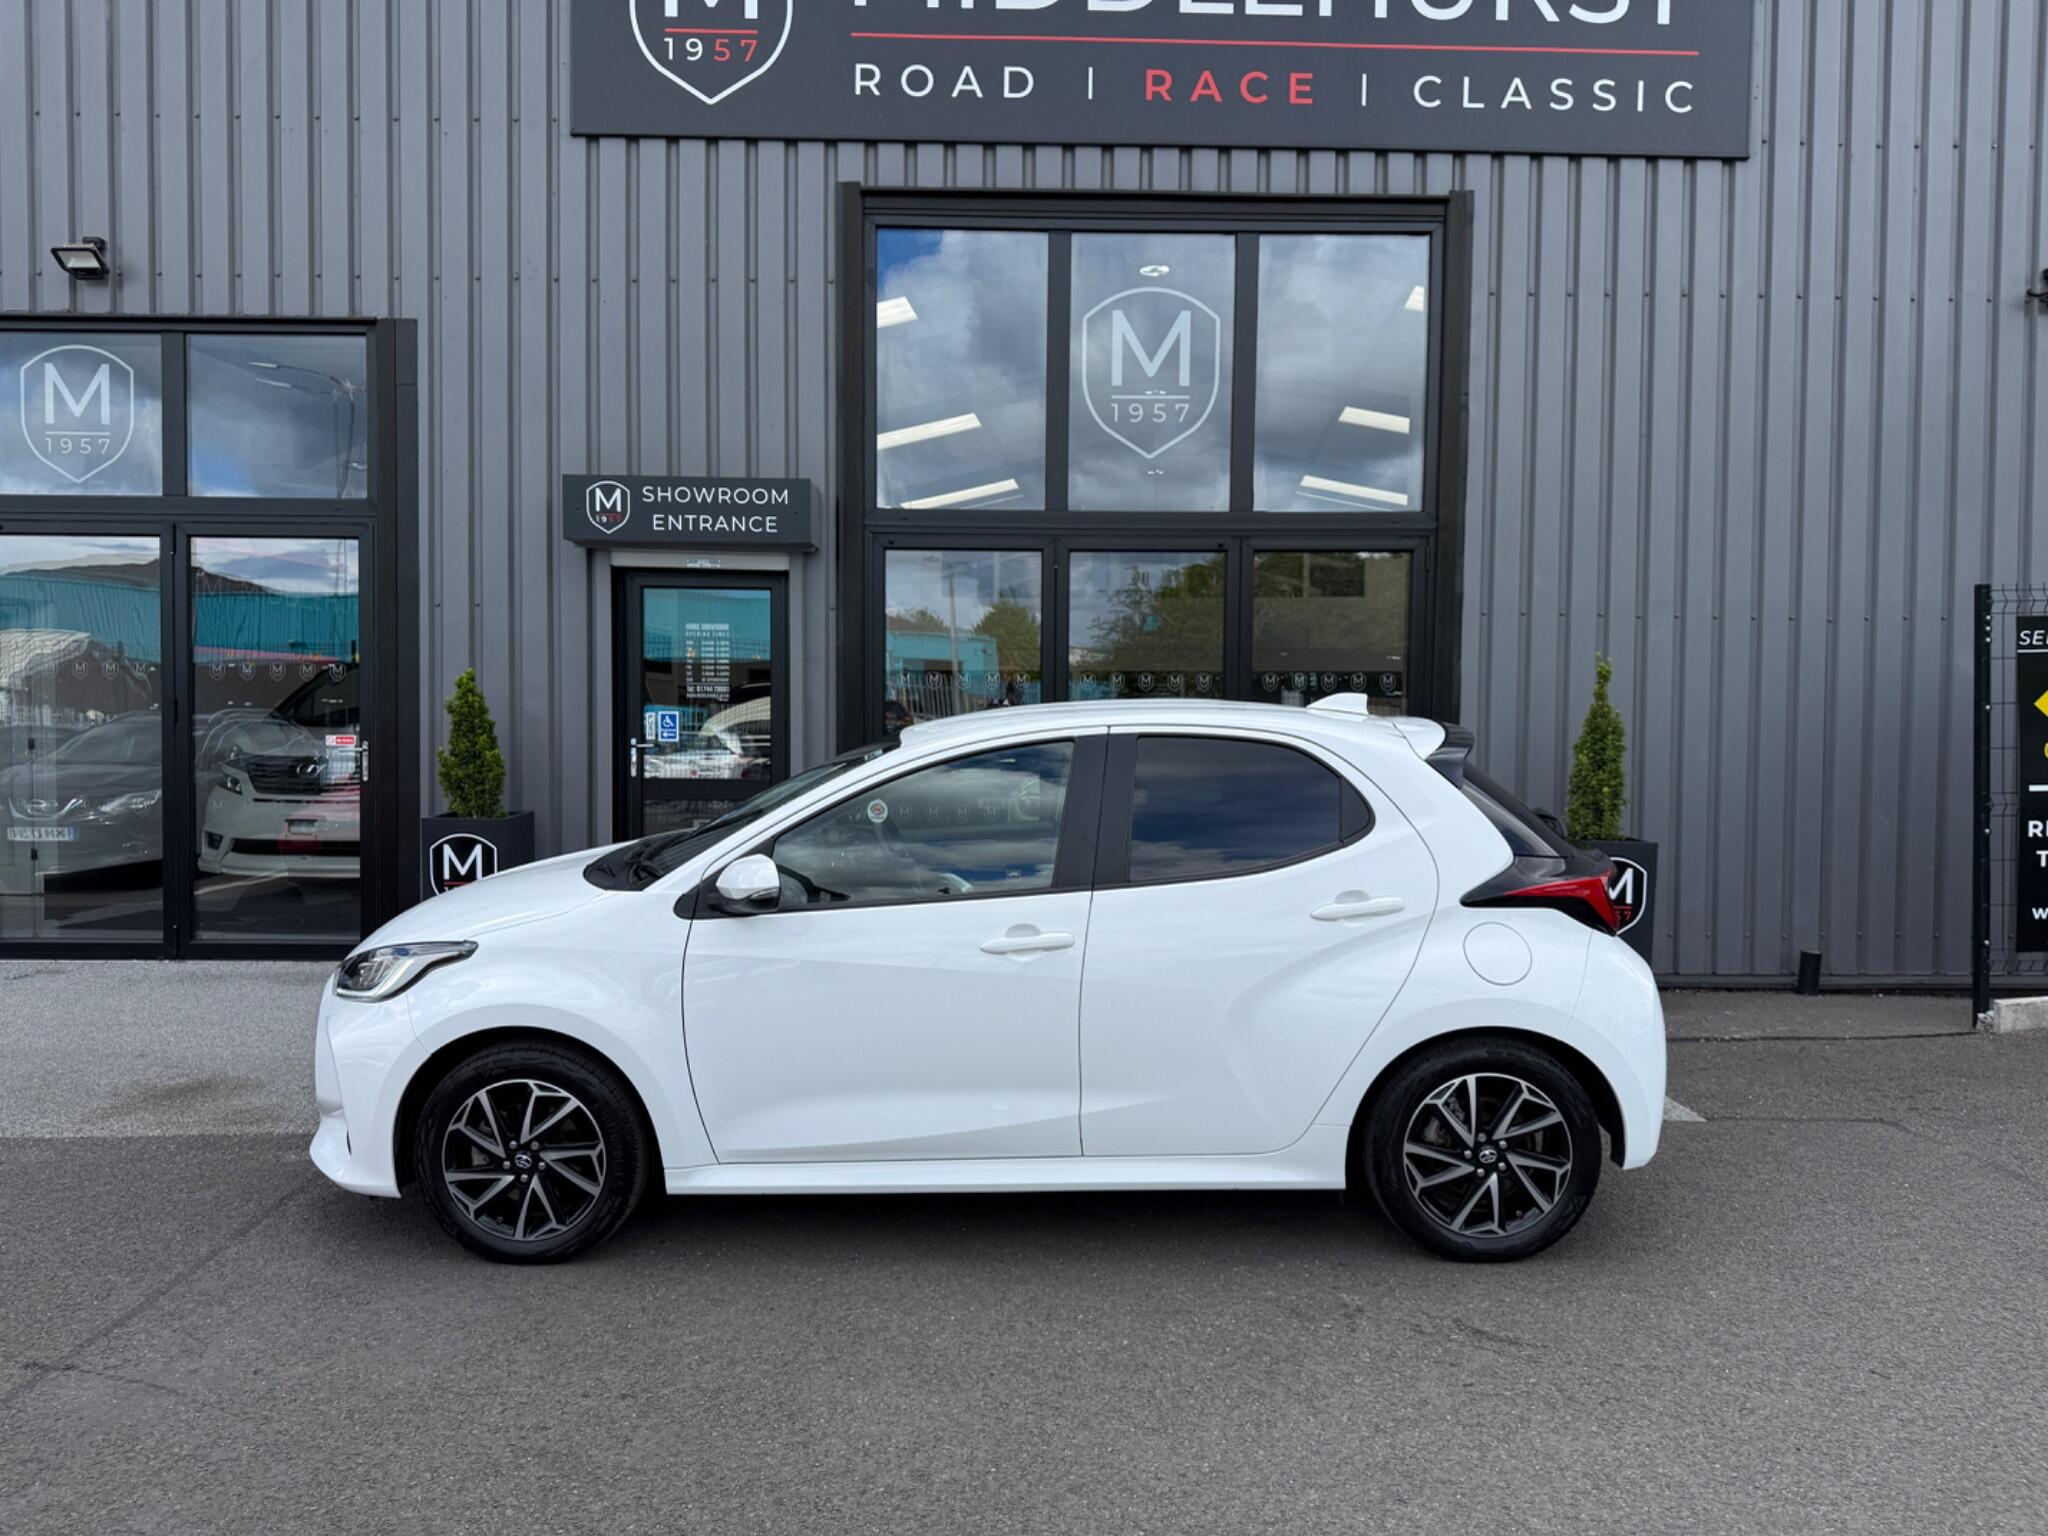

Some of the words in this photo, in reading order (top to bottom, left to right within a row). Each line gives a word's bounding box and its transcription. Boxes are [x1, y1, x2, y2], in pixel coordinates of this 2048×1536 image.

[663, 37, 758, 63] 1957
[854, 63, 1035, 99] ROAD
[1145, 68, 1313, 104] RACE
[1413, 75, 1694, 114] CLASSIC
[1111, 309, 1192, 387] M
[44, 362, 111, 425] M
[1111, 402, 1190, 423] 1957
[44, 437, 110, 455] 1957
[595, 487, 622, 513] M
[641, 485, 789, 505] SHOWROOM
[652, 514, 779, 533] ENTRANCE
[2018, 630, 2048, 645] SE
[2027, 820, 2048, 838] R
[443, 843, 483, 881] M
